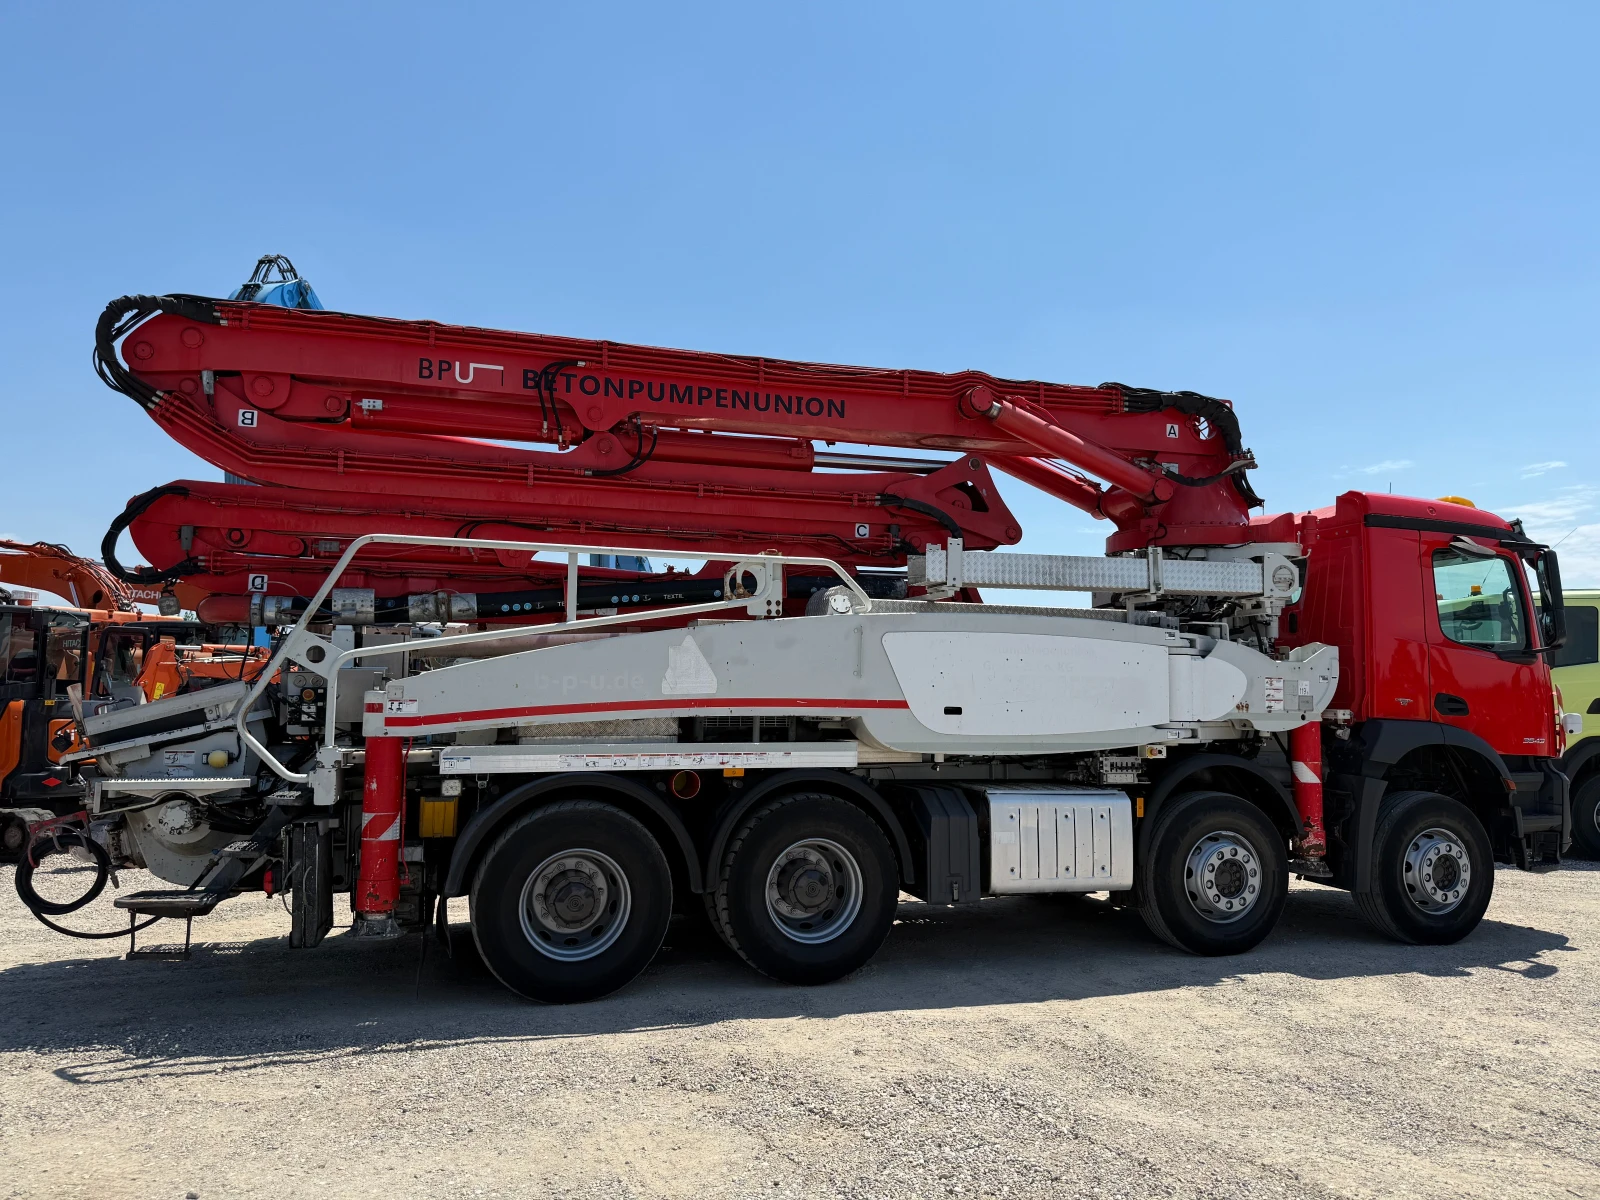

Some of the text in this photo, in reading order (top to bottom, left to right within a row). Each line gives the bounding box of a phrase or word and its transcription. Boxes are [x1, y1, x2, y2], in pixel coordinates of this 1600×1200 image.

[418, 357, 846, 419] BPU BETONPUMPENUNION
[241, 410, 255, 426] B
[1167, 424, 1178, 438] A
[856, 524, 868, 537] C
[251, 575, 265, 591] D
[662, 593, 685, 601] TEXTIL
